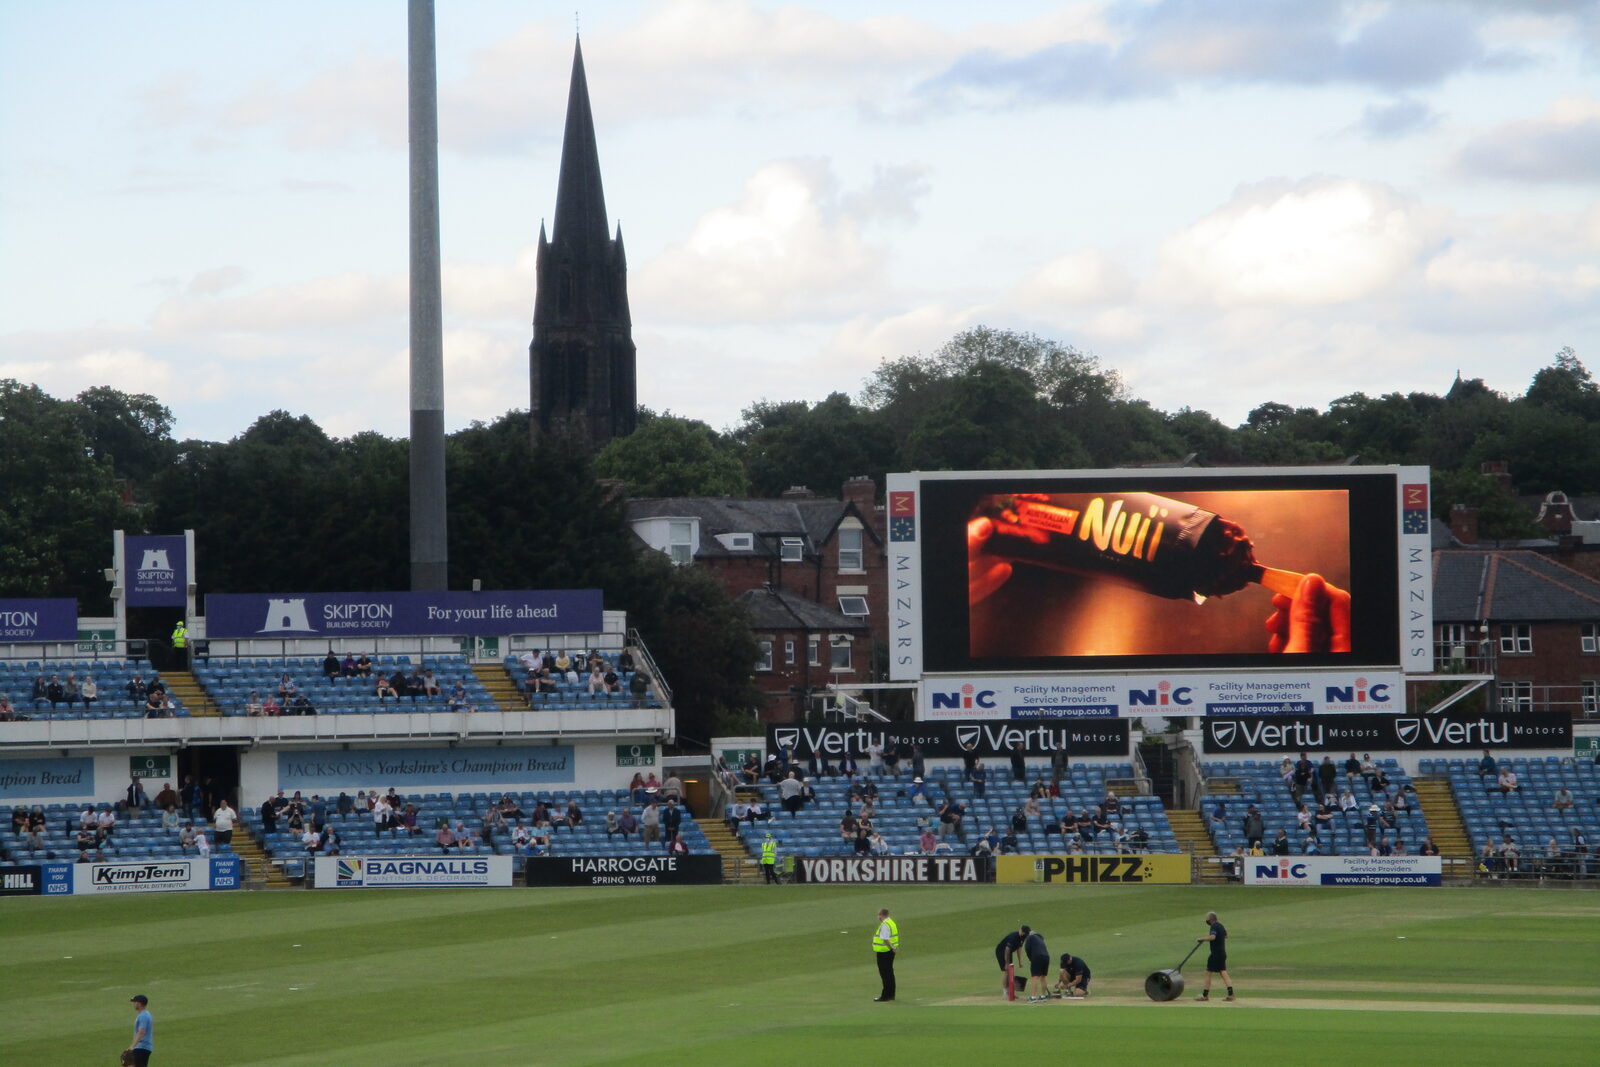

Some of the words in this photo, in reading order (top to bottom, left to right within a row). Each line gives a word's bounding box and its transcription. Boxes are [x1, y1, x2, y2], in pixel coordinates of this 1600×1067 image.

[896, 496, 911, 512] M
[1408, 488, 1424, 504] M
[138, 572, 174, 580] SKIPTON
[1409, 548, 1425, 656] MAZARS
[323, 604, 392, 619] SKIPTON
[428, 606, 451, 619] For
[455, 608, 487, 622] your
[491, 605, 512, 618] life
[516, 604, 558, 618] ahead
[896, 556, 912, 665] MAZARS
[0, 612, 37, 626] TON
[5, 629, 35, 637] SOCIETY
[1014, 686, 1048, 694] Facility
[1052, 685, 1116, 694] Management
[1209, 683, 1243, 692] Facility
[1246, 682, 1310, 691] Management
[1018, 707, 1112, 717] wwwnicgroup.co.uk
[984, 724, 1066, 750] Vertu
[1072, 733, 1121, 742] Motors
[1240, 721, 1323, 746] Vertu
[1329, 728, 1379, 737] Motors
[1424, 718, 1508, 743] Vertu
[1514, 726, 1565, 735] Motors
[803, 727, 885, 753] Vertu
[891, 736, 940, 744] Motors
[286, 760, 374, 777] JACKSON'S
[378, 760, 448, 775] Yorkshire's
[452, 759, 523, 775] Champion
[528, 757, 567, 771] Bread
[41, 769, 81, 785] Bread
[367, 862, 488, 875] BAGNALLS
[572, 857, 677, 872] HARROGATE
[802, 859, 928, 882] YORKSHIRE
[935, 859, 977, 882] TEA
[1044, 858, 1143, 882] PHIZZ
[4, 874, 34, 888] HILL
[97, 866, 184, 884] KrimpTerm
[1335, 876, 1427, 884] www.nicgroup.co.uk
